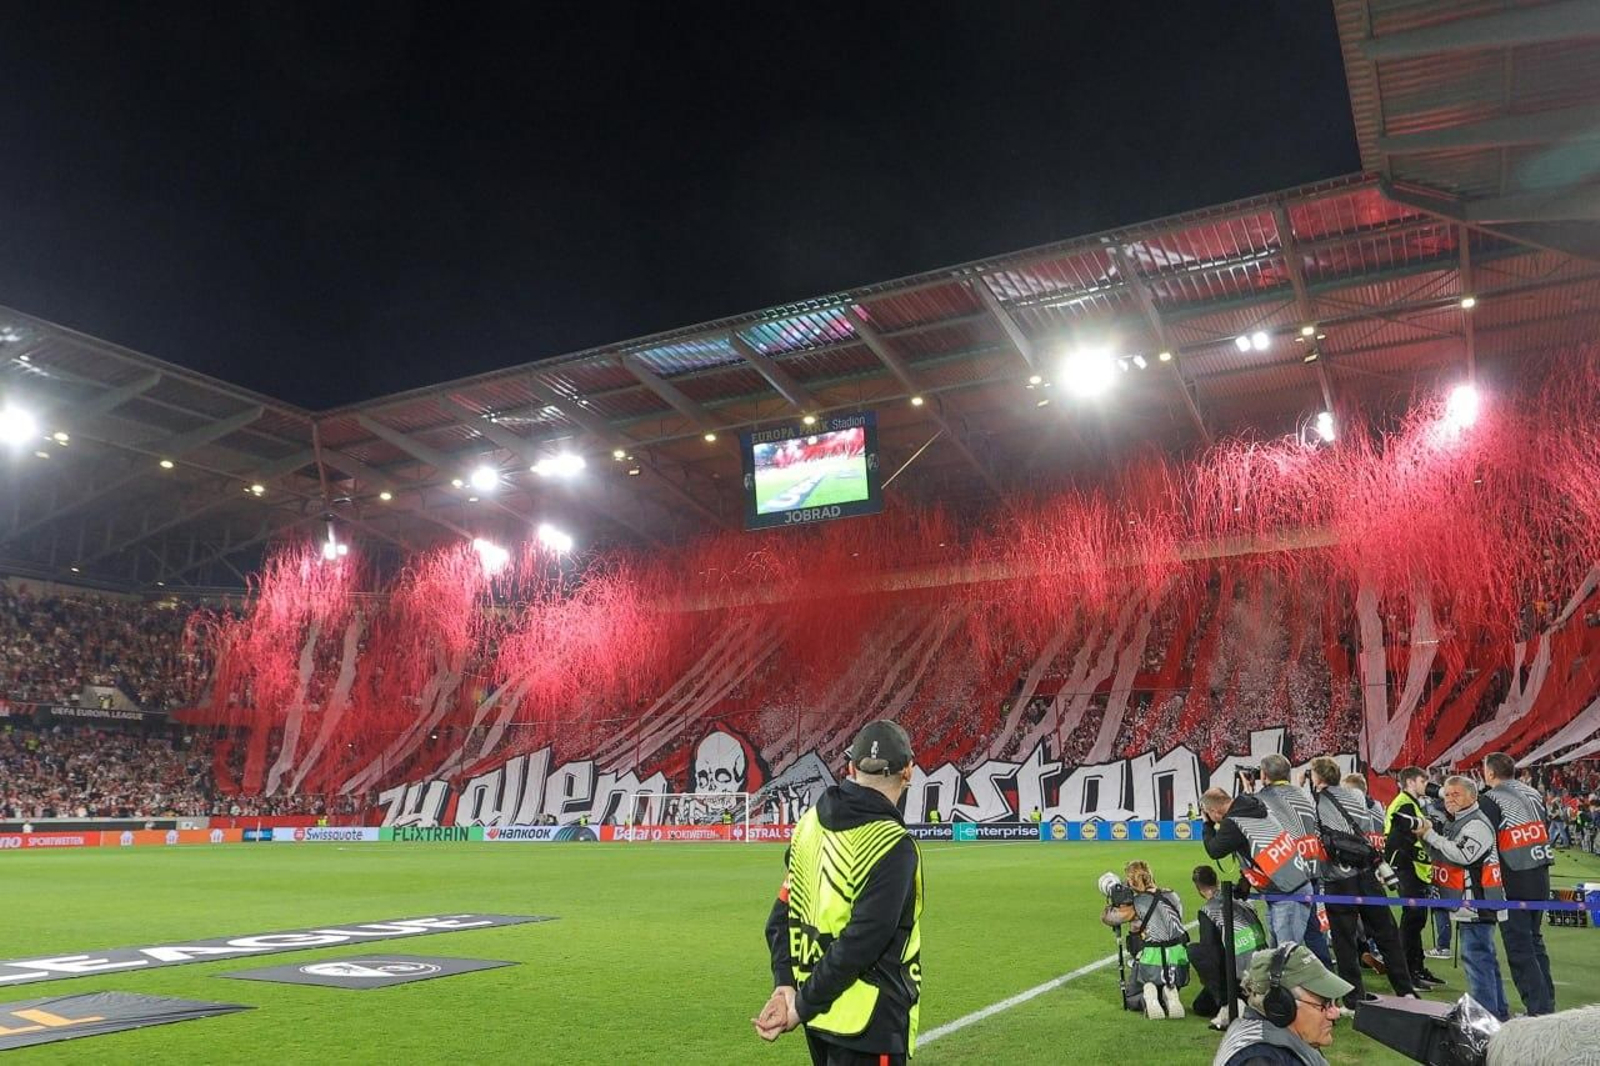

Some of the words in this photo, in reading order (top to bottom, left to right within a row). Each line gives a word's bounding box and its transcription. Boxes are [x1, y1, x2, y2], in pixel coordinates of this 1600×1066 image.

[751, 427, 795, 443] EUROPA
[784, 506, 841, 523] JOBRAD
[51, 707, 75, 716] UEFA
[76, 709, 110, 719] EUROPA
[111, 711, 143, 720] LEAGUE
[306, 828, 363, 841] Swissquote
[965, 825, 1039, 838] enterprise
